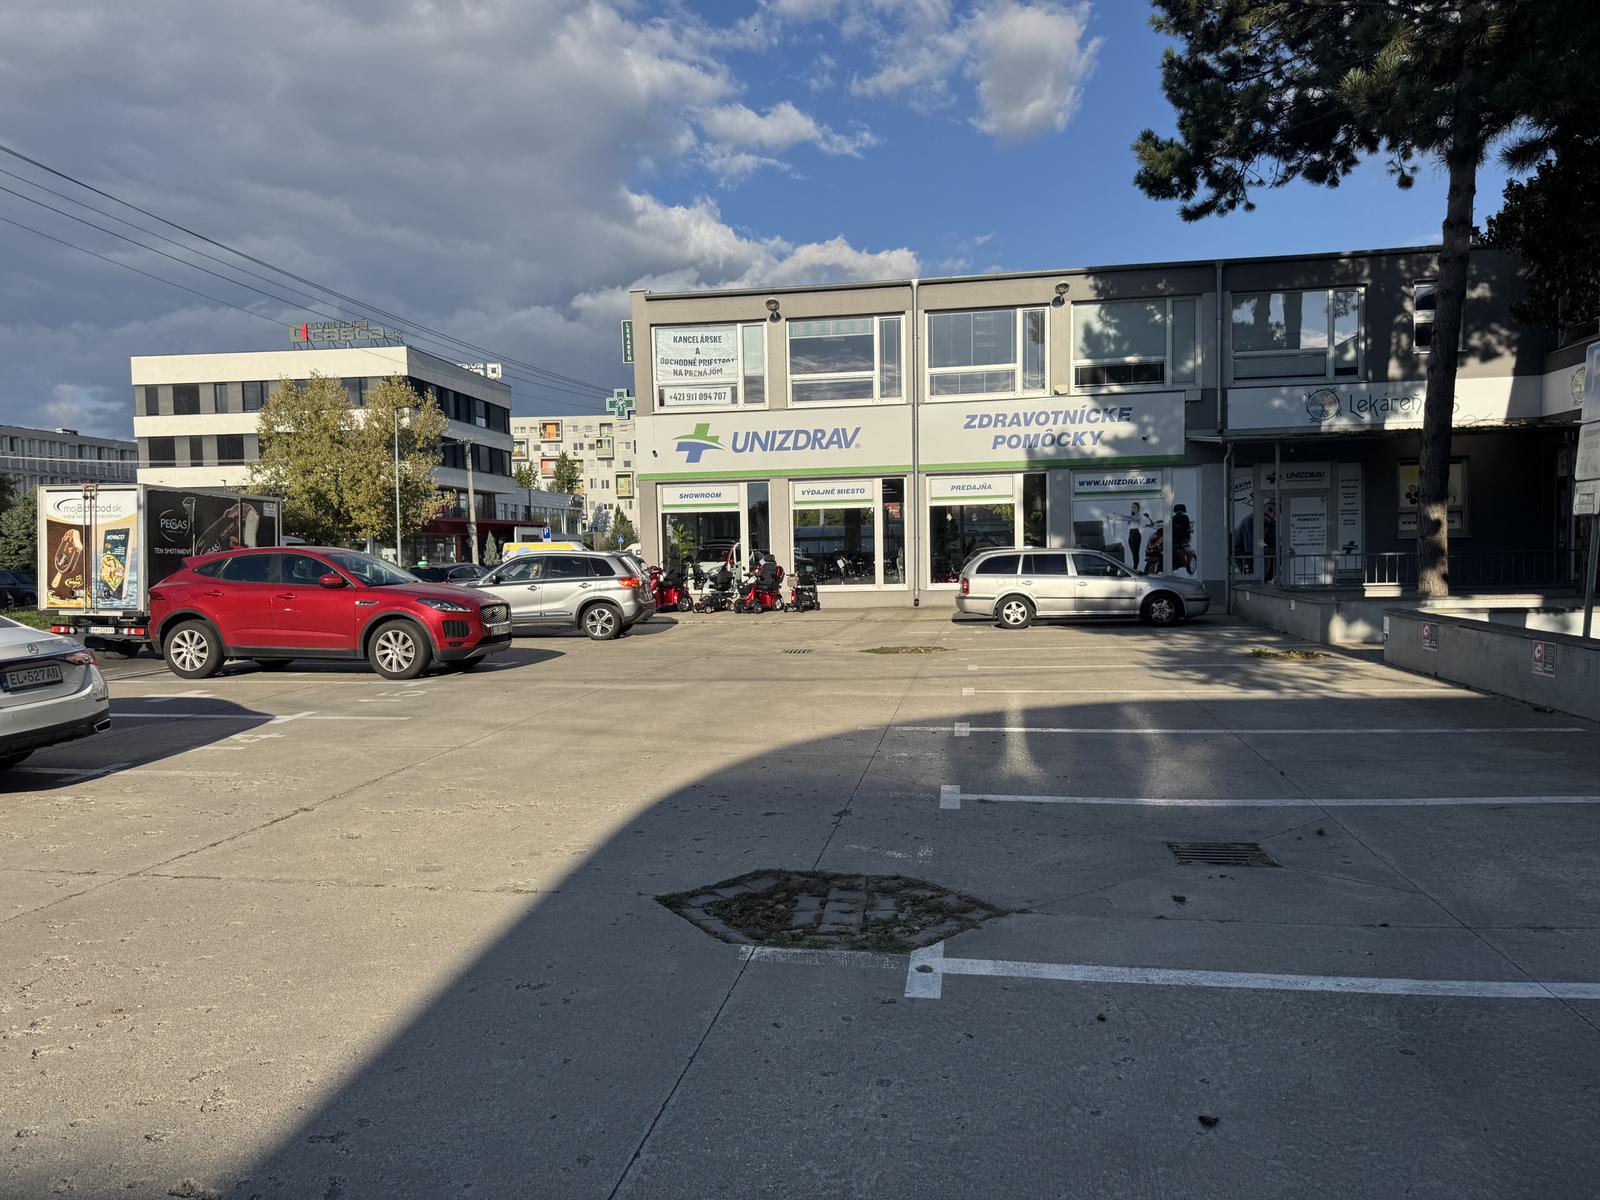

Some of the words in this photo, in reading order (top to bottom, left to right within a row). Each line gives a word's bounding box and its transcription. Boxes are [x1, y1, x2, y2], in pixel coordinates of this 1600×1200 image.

[673, 333, 722, 344] KANCELÁRSKE
[695, 347, 700, 355] A
[660, 357, 697, 367] OBCHODNÉ
[673, 369, 683, 377] NA
[684, 367, 723, 377] PRENÁJOM
[669, 392, 685, 402] +421
[686, 392, 697, 401] 911
[699, 392, 712, 401] 094
[714, 391, 727, 401] 707
[1350, 392, 1422, 419] Lekáreň
[963, 405, 1133, 430] ZDRAVOTNÍCKE
[731, 426, 861, 454] UNIZDRAV
[991, 428, 1104, 450] POMÔCKY
[950, 482, 992, 492] PREDAJŇA
[1078, 476, 1157, 488] WWW.UNIZDRAV.SK
[679, 492, 722, 500] SHOWROOM
[801, 487, 836, 496] VÝDAJNÉ
[836, 487, 865, 496] MIESTO
[160, 518, 187, 530] PEGAS
